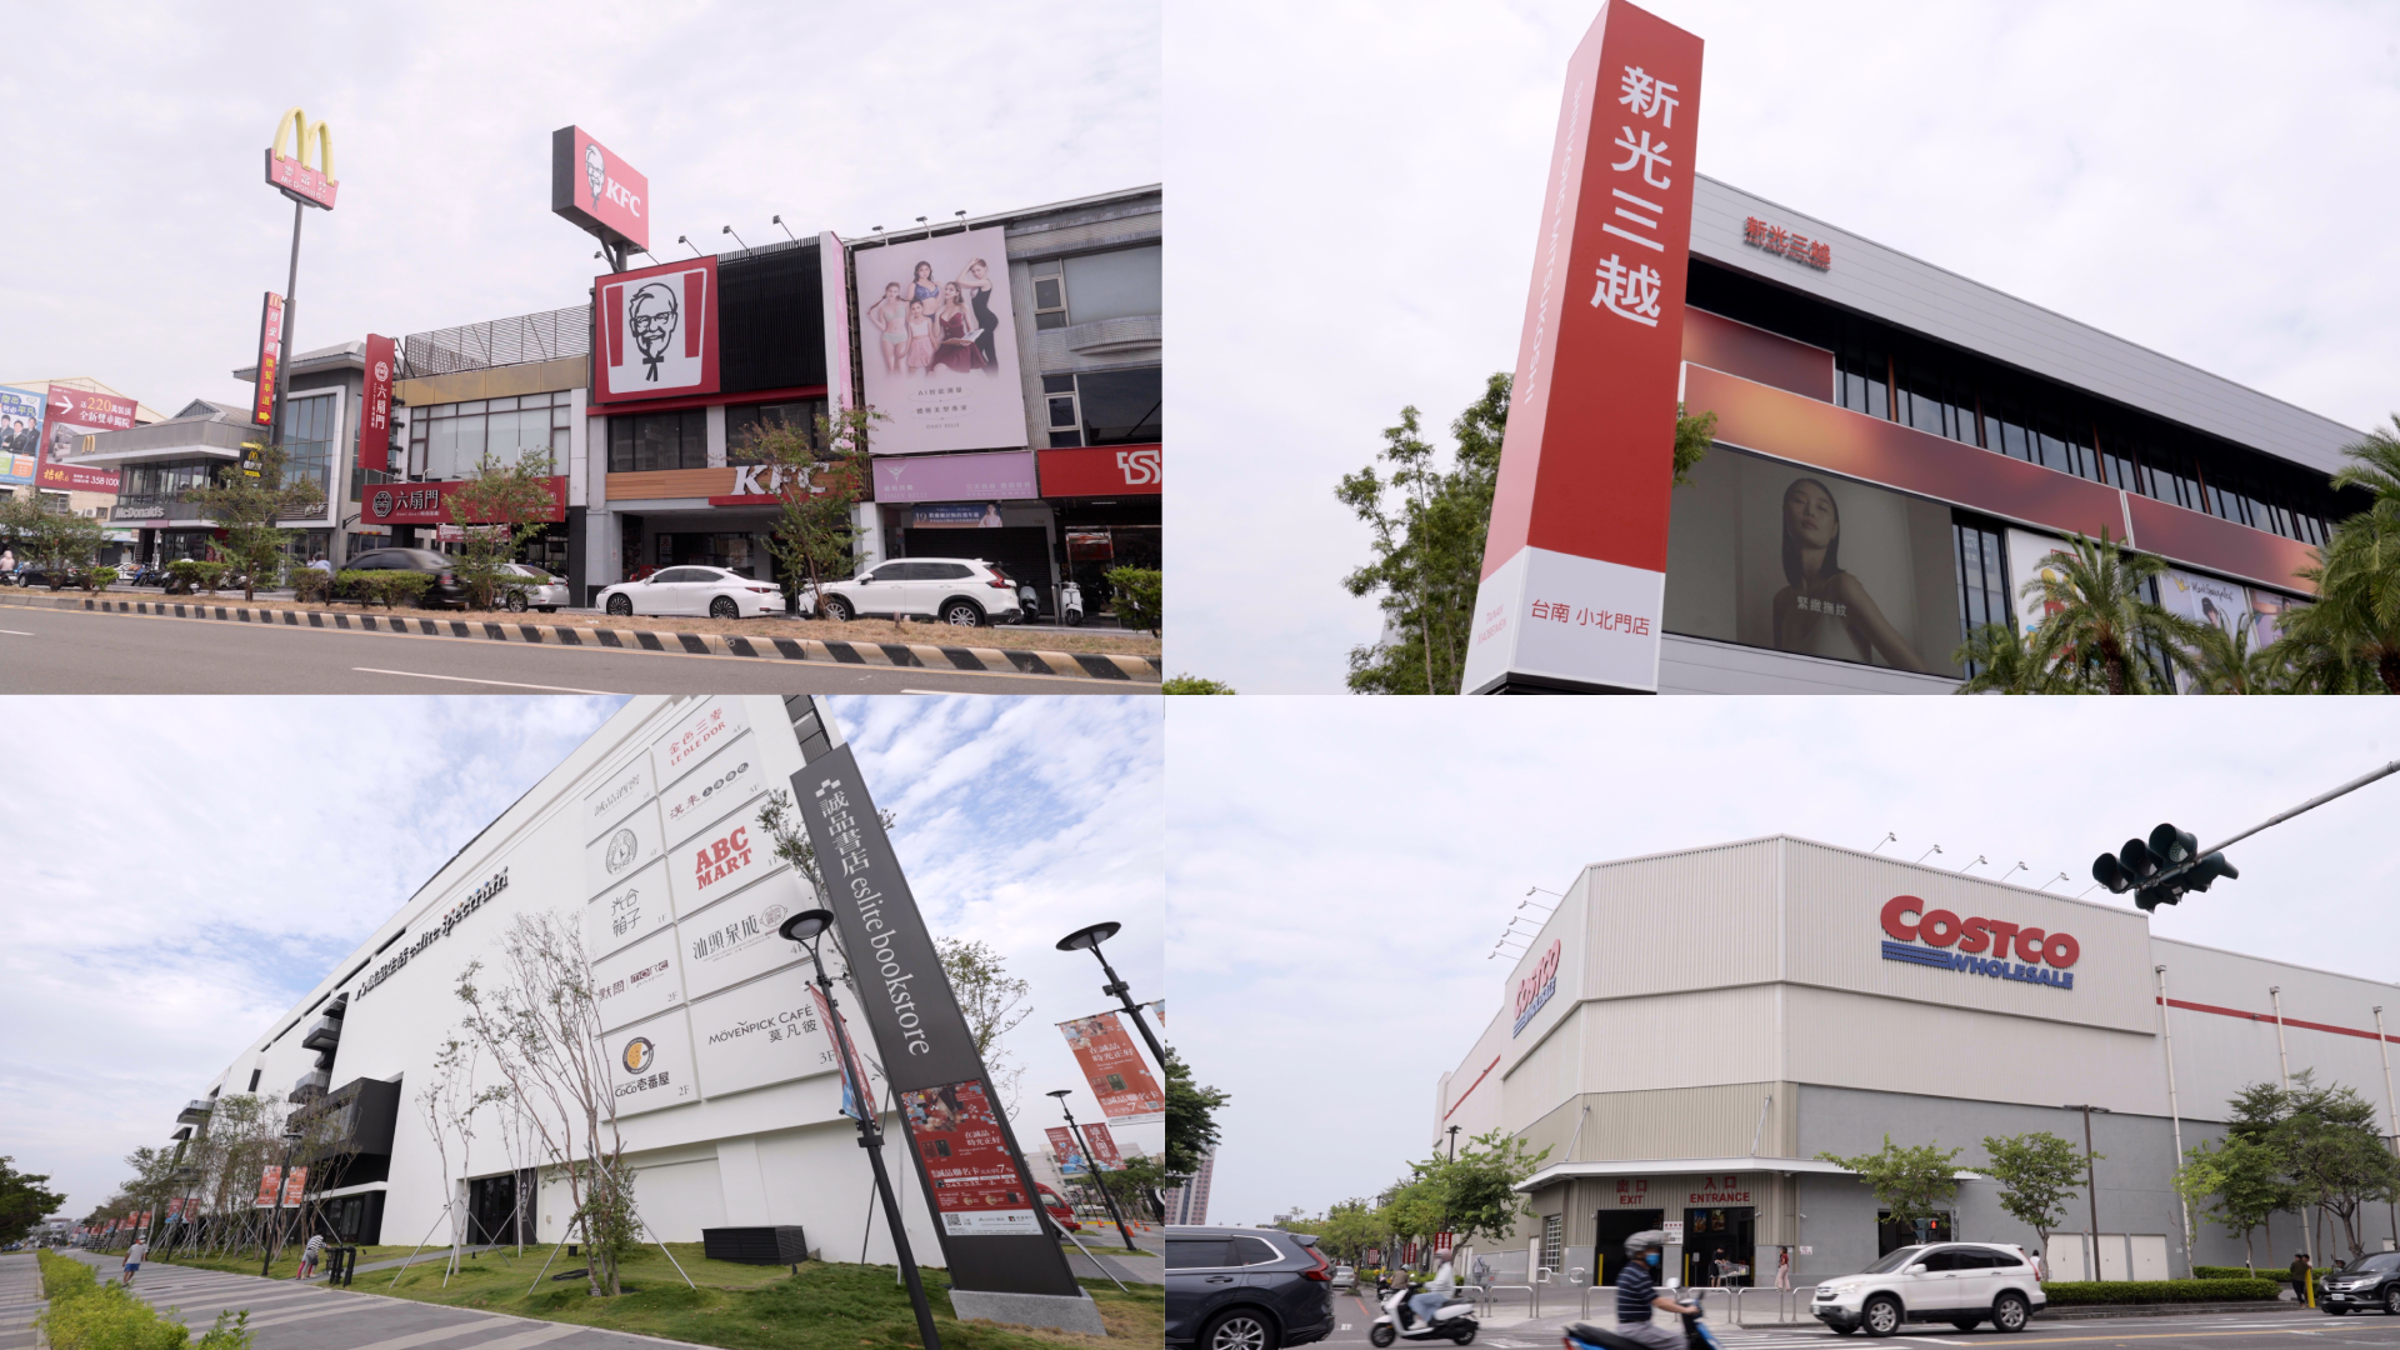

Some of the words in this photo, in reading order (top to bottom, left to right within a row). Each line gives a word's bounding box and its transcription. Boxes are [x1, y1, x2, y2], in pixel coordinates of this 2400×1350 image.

[281, 175, 326, 202] McDonald's
[605, 177, 641, 218] KFC
[1592, 64, 1680, 328] 新光三越
[1746, 216, 1831, 264] 新光三越
[375, 384, 387, 430] 六扇門
[731, 462, 830, 496] KFC
[115, 505, 165, 519] McDonald's
[396, 490, 440, 510] 六扇門
[1531, 599, 1570, 623] 台南
[1576, 607, 1651, 636] 小北門店
[1797, 595, 1848, 617] 緊緻撫紋
[668, 707, 723, 756] 金色三麥
[695, 825, 749, 874] ABC
[695, 847, 753, 890] MART
[612, 907, 641, 938] 箱子
[692, 914, 760, 960] 汕頭泉成
[819, 790, 871, 878] 誠品書店
[850, 875, 885, 934] eslite
[869, 930, 930, 1058] bookstore
[1880, 895, 2080, 969] COSTCO
[1514, 939, 1561, 1021] COSTCO
[1946, 952, 2074, 990] WHOLESALE
[668, 991, 679, 1003] 2F
[777, 1003, 814, 1024] CAFÉ
[768, 1019, 819, 1044] 莫凡彼
[818, 1050, 836, 1066] 3F
[678, 1085, 690, 1097] 2F
[1616, 1179, 1648, 1194] 出口
[1689, 1191, 1751, 1204] ENTRANCE
[1704, 1175, 1737, 1190] 入口
[1619, 1194, 1644, 1206] EXIT
